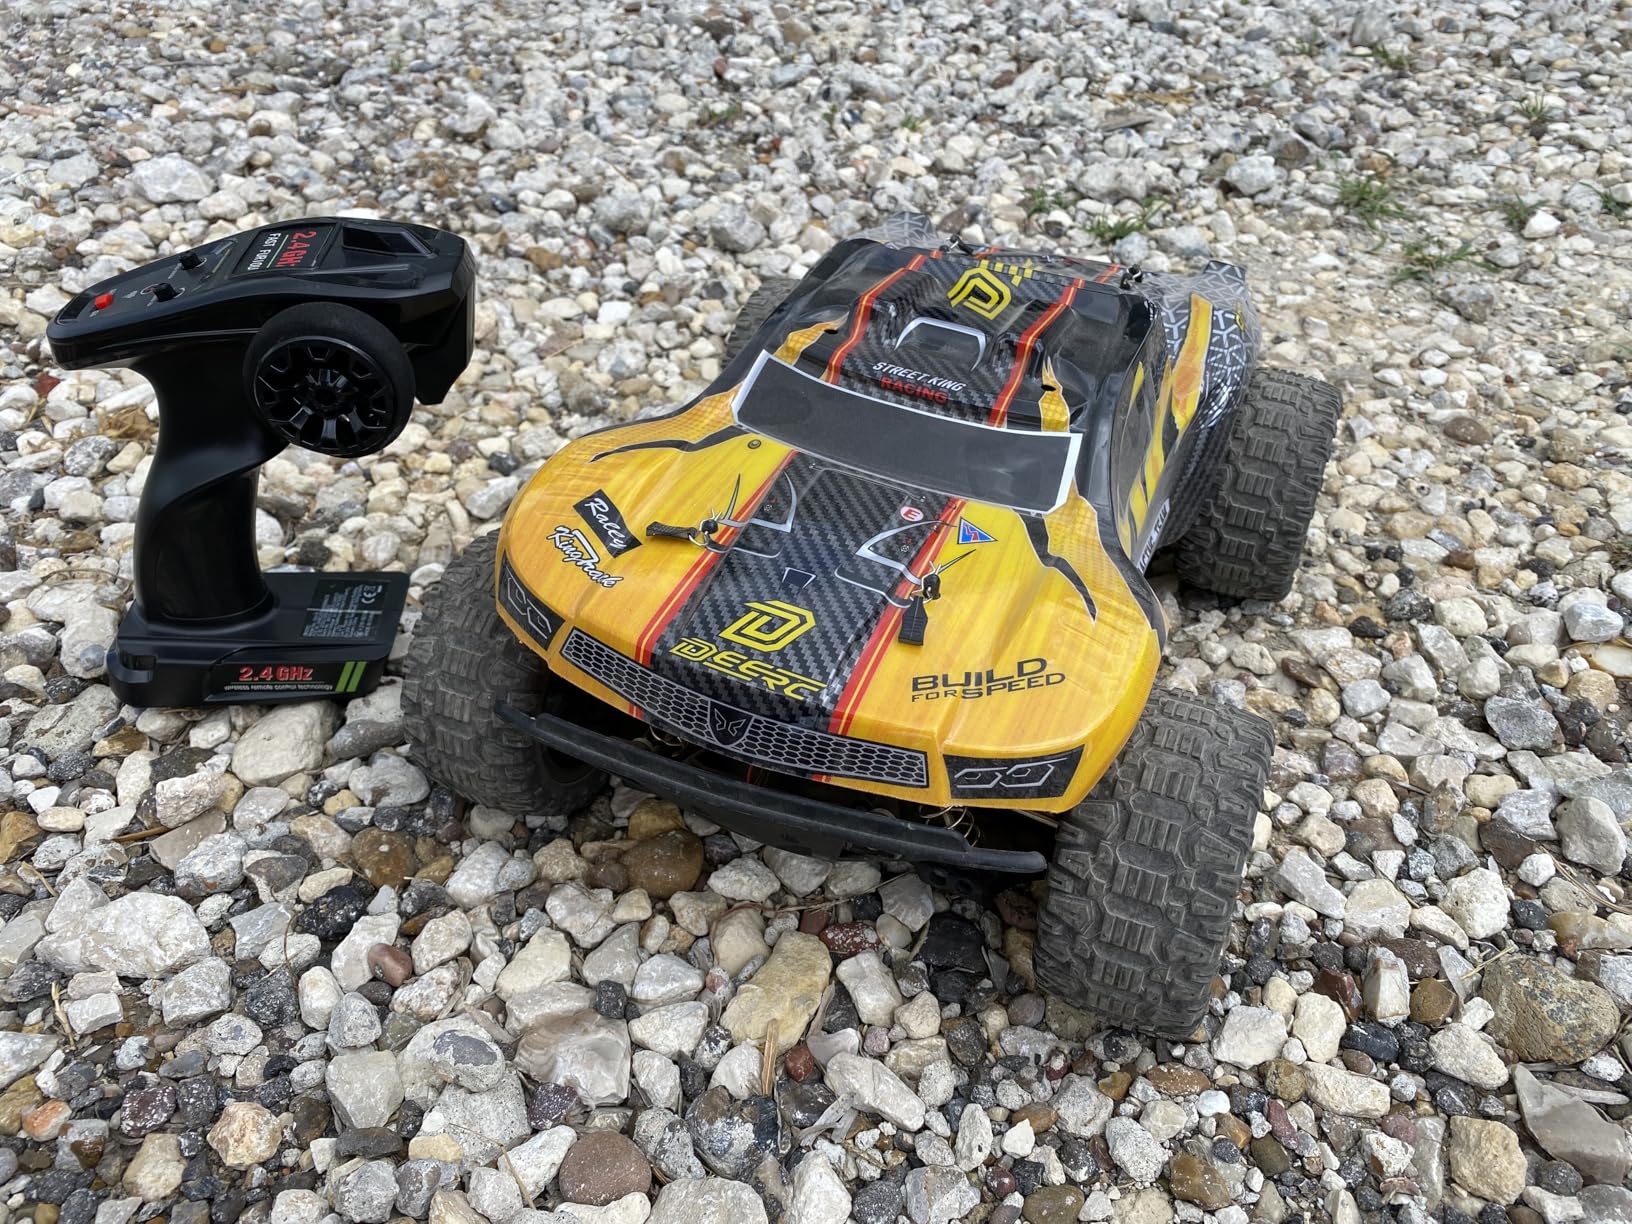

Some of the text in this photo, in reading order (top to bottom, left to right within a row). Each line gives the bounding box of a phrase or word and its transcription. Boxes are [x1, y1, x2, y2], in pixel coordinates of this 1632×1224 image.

[262, 233, 282, 247] FAST
[872, 361, 967, 392] STREET KING
[880, 376, 949, 405] RACING
[584, 498, 627, 549] Rally
[670, 638, 828, 700] DEERC
[912, 657, 1048, 692] BUILD
[911, 672, 1066, 702] FOR SPEED
